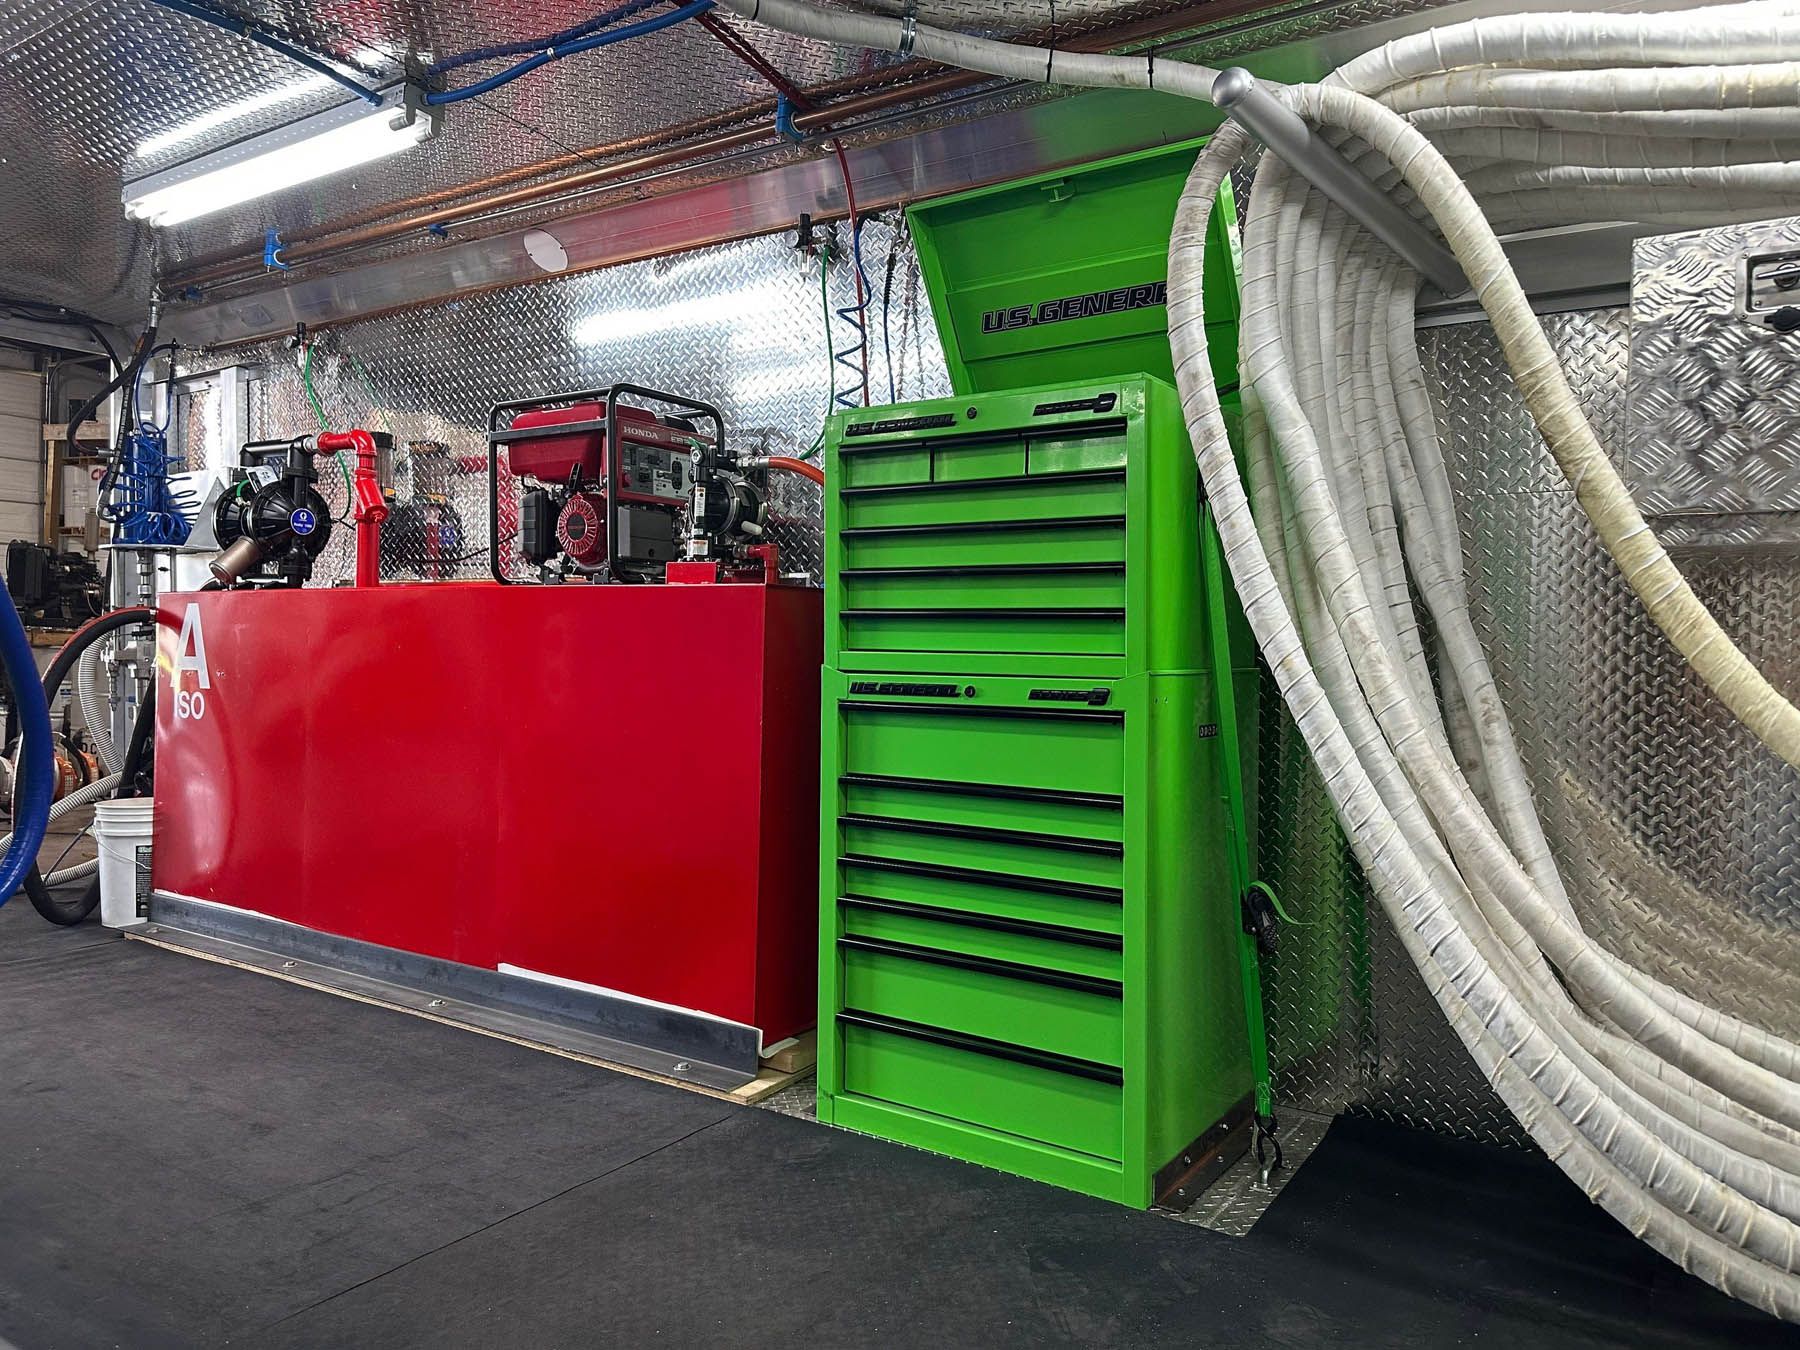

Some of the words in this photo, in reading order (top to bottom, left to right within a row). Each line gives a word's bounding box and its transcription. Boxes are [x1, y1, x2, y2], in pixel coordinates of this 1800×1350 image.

[1036, 281, 1168, 325] GENERA
[623, 426, 659, 440] HONDA
[170, 602, 211, 689] A
[174, 690, 206, 720] ISO
